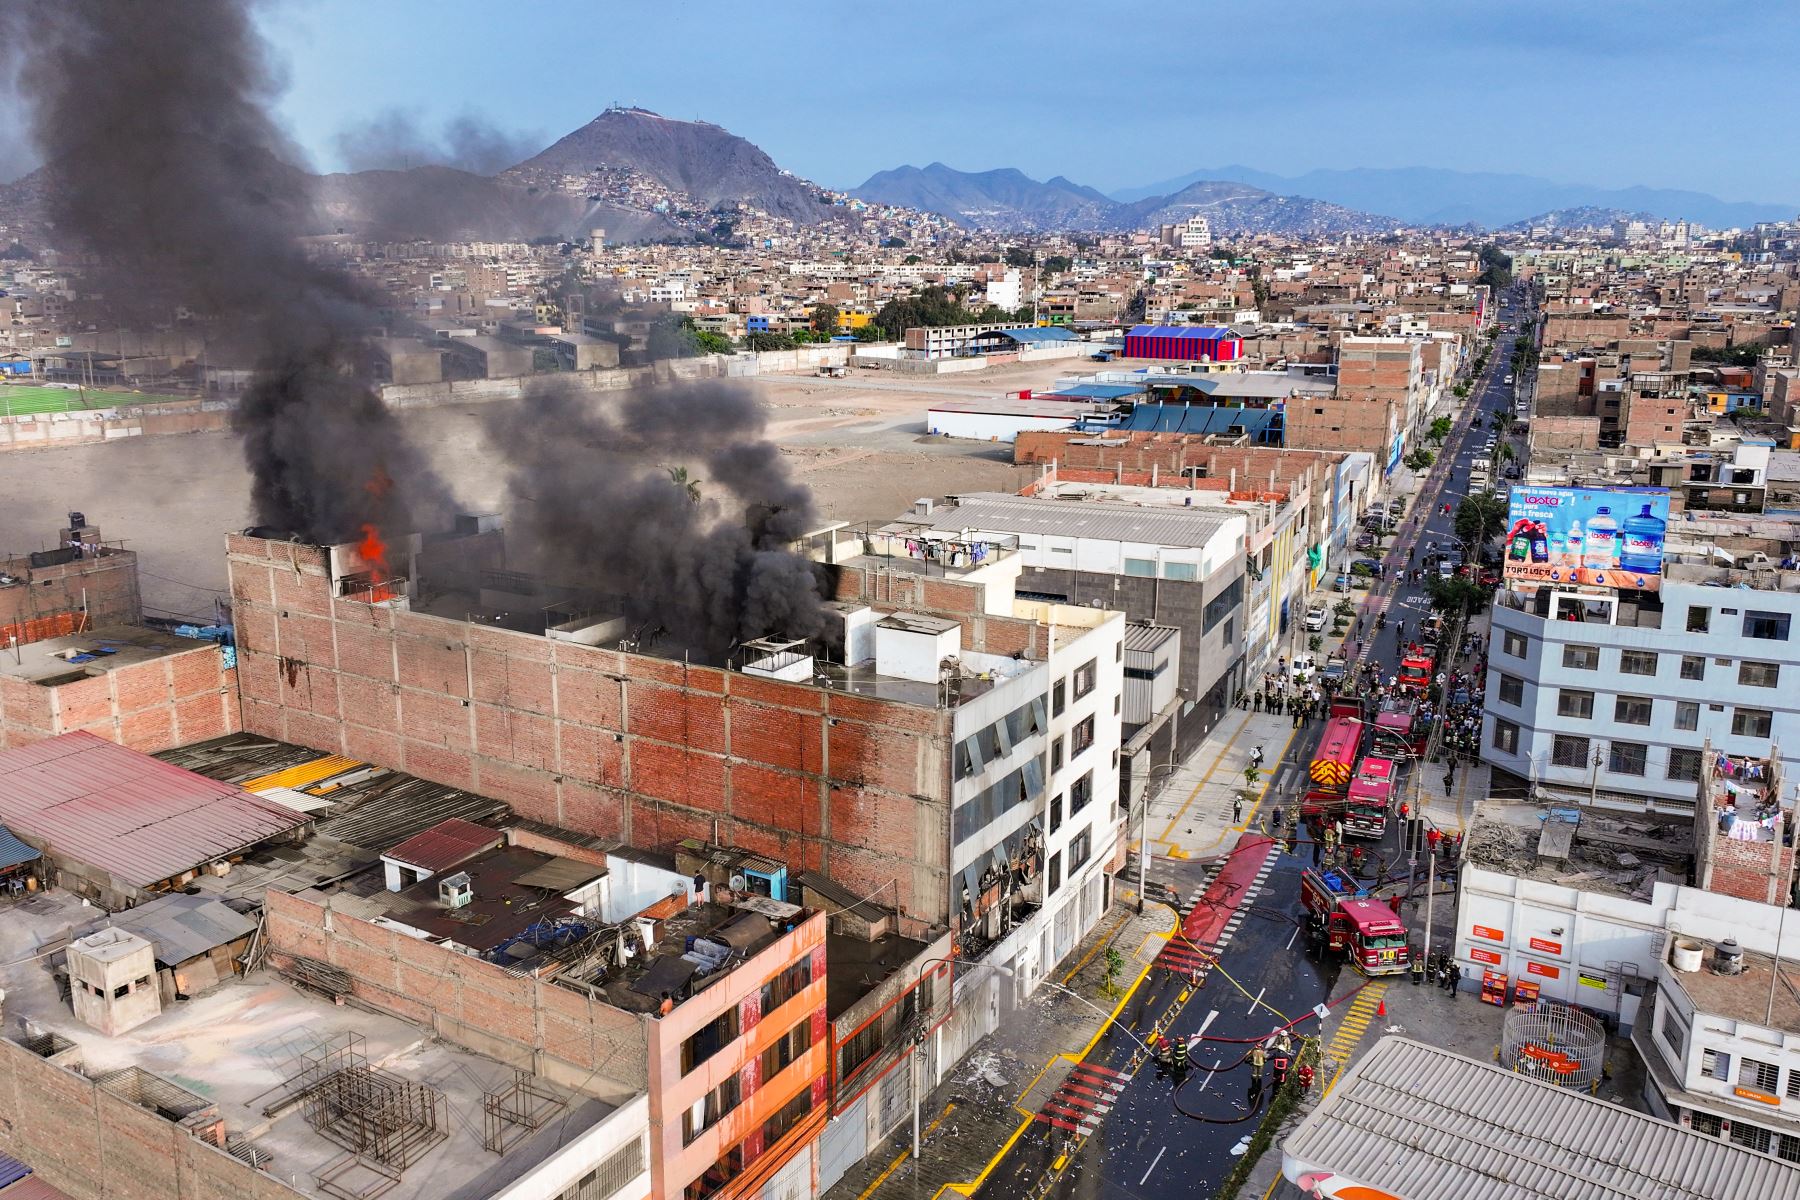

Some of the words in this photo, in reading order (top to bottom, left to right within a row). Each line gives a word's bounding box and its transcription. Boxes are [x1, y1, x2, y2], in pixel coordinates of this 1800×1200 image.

[1506, 566, 1529, 575] TORO
[1529, 568, 1551, 576] LOCO
[1383, 950, 1395, 960] 10
